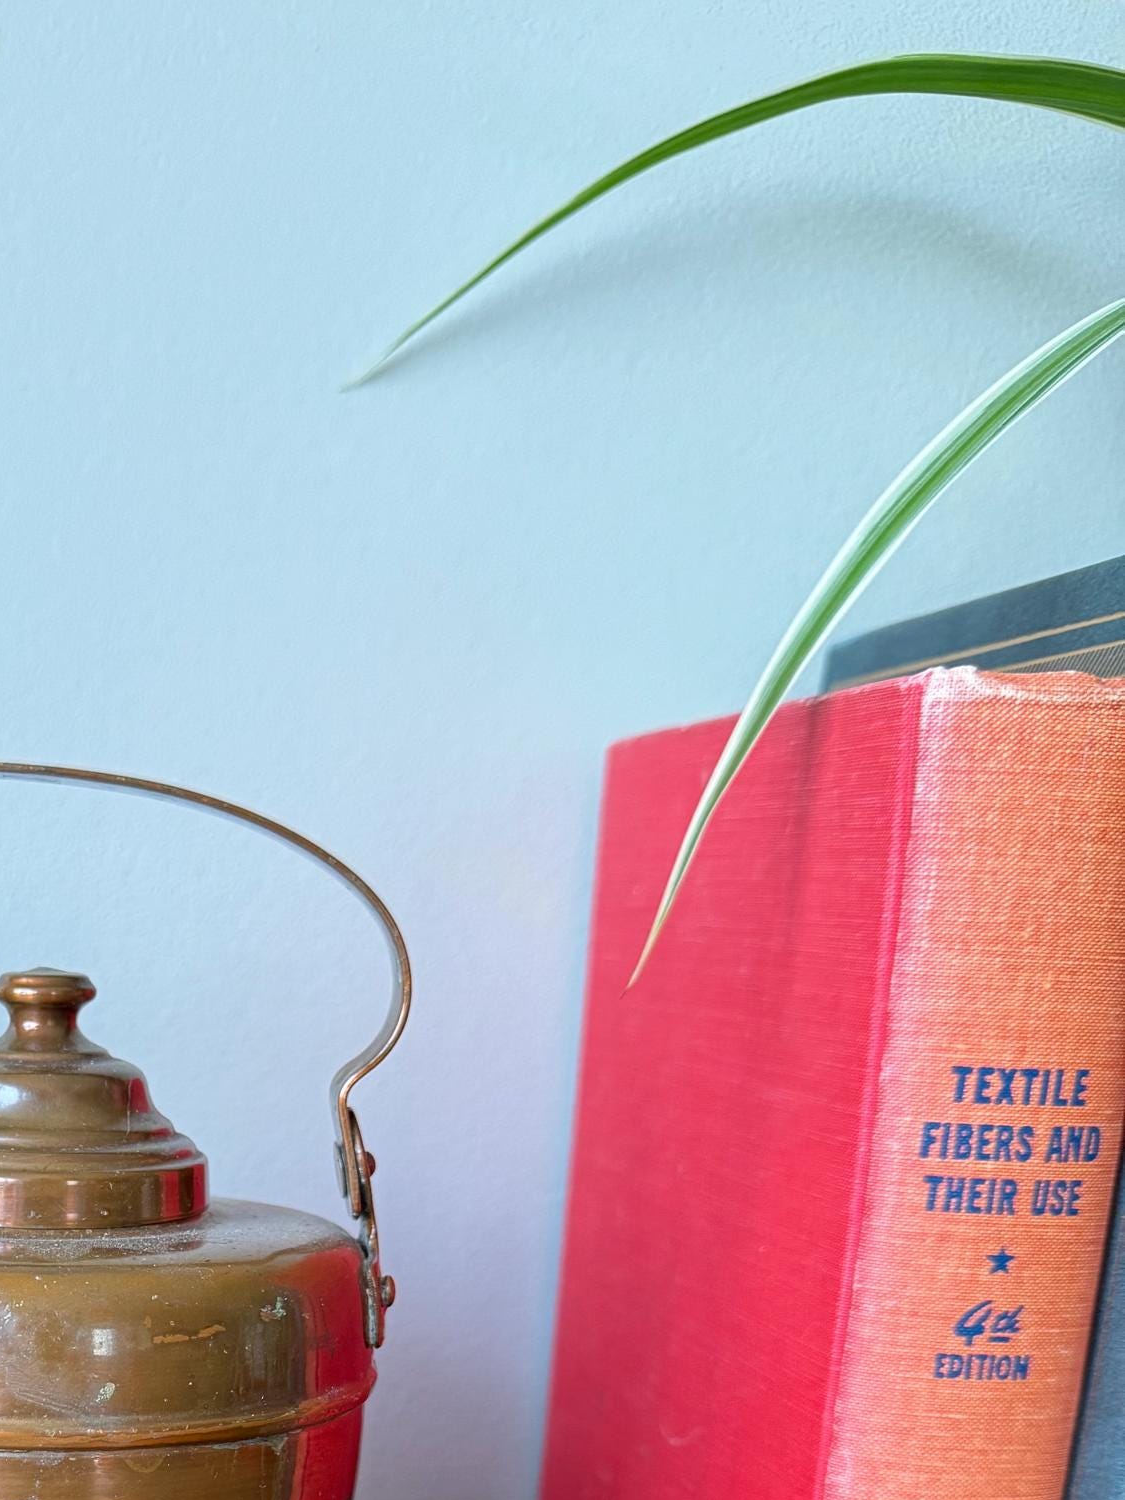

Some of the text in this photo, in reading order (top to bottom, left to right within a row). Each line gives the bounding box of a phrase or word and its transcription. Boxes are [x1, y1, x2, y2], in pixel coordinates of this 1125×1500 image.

[951, 1066, 1090, 1107] TEXTILE
[919, 1122, 1101, 1163] FIBERS AND
[924, 1176, 1083, 1216] THEIR USE
[953, 1300, 1025, 1346] 4th
[934, 1353, 1031, 1380] EDITION
